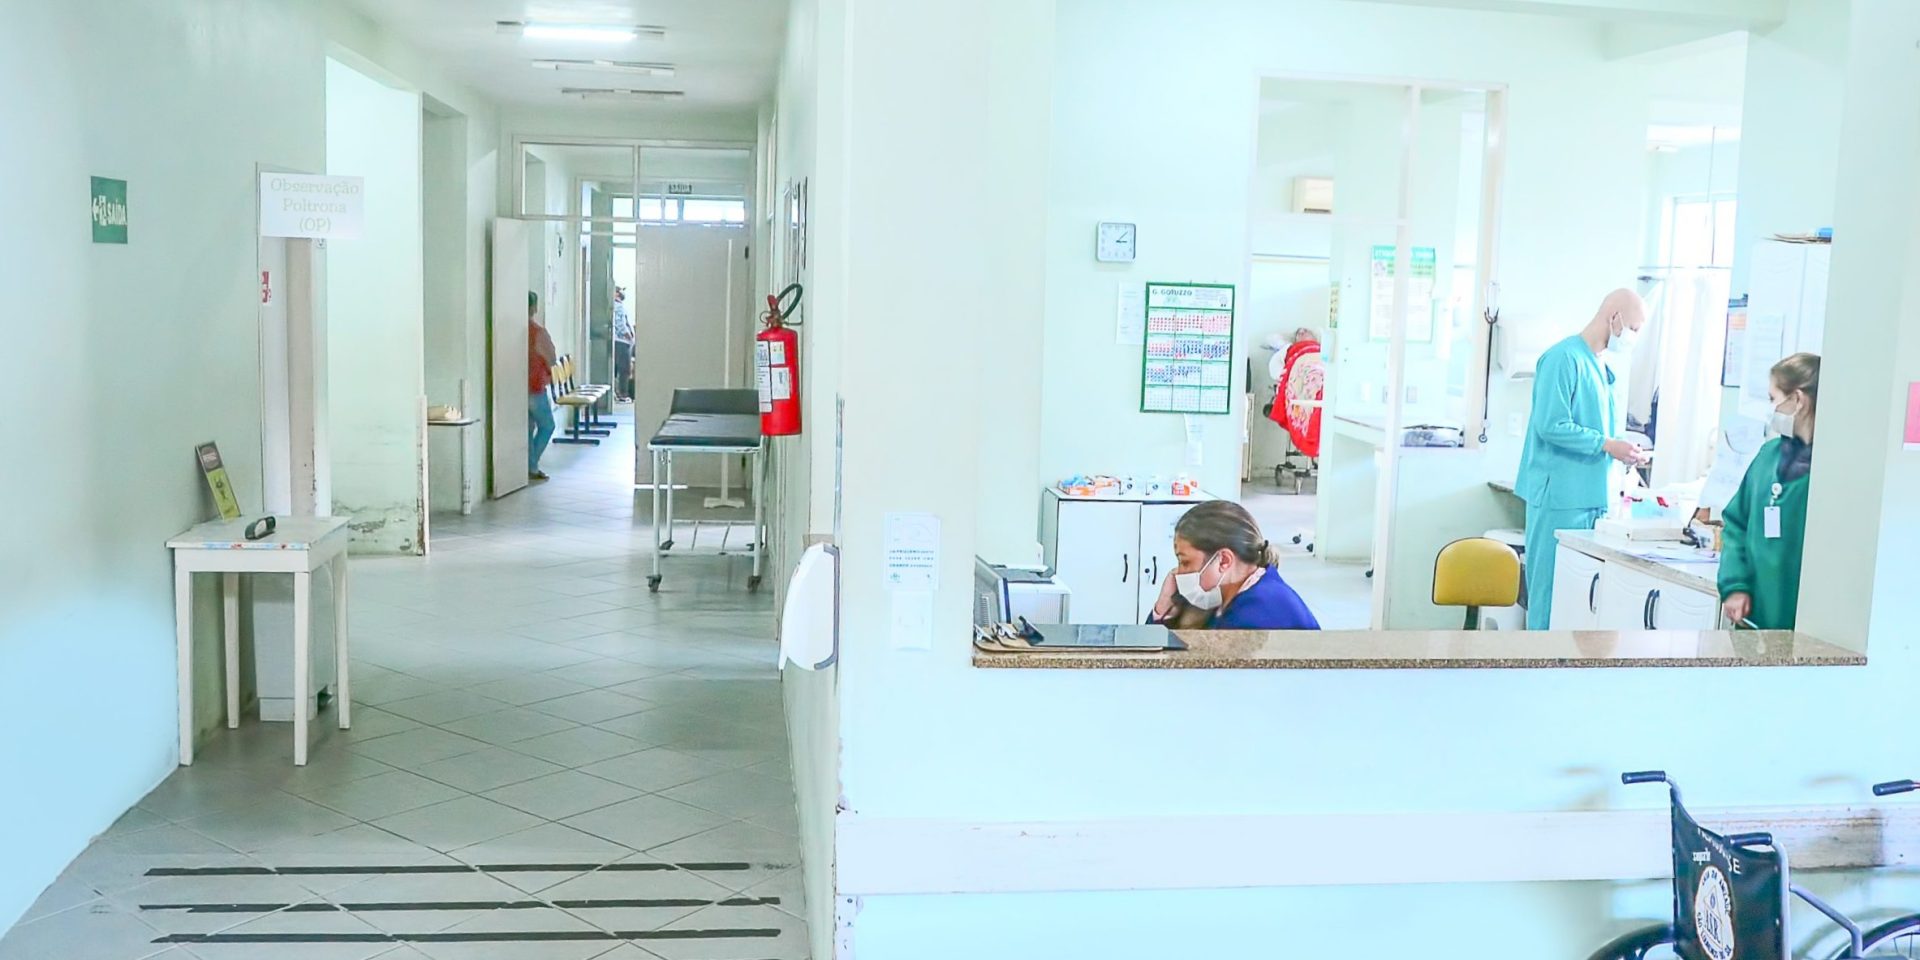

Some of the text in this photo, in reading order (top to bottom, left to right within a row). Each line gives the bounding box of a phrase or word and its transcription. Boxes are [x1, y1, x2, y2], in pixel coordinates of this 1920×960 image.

[270, 177, 360, 197] Observação
[282, 197, 347, 213] Poltrona
[298, 217, 332, 233] (OP)
